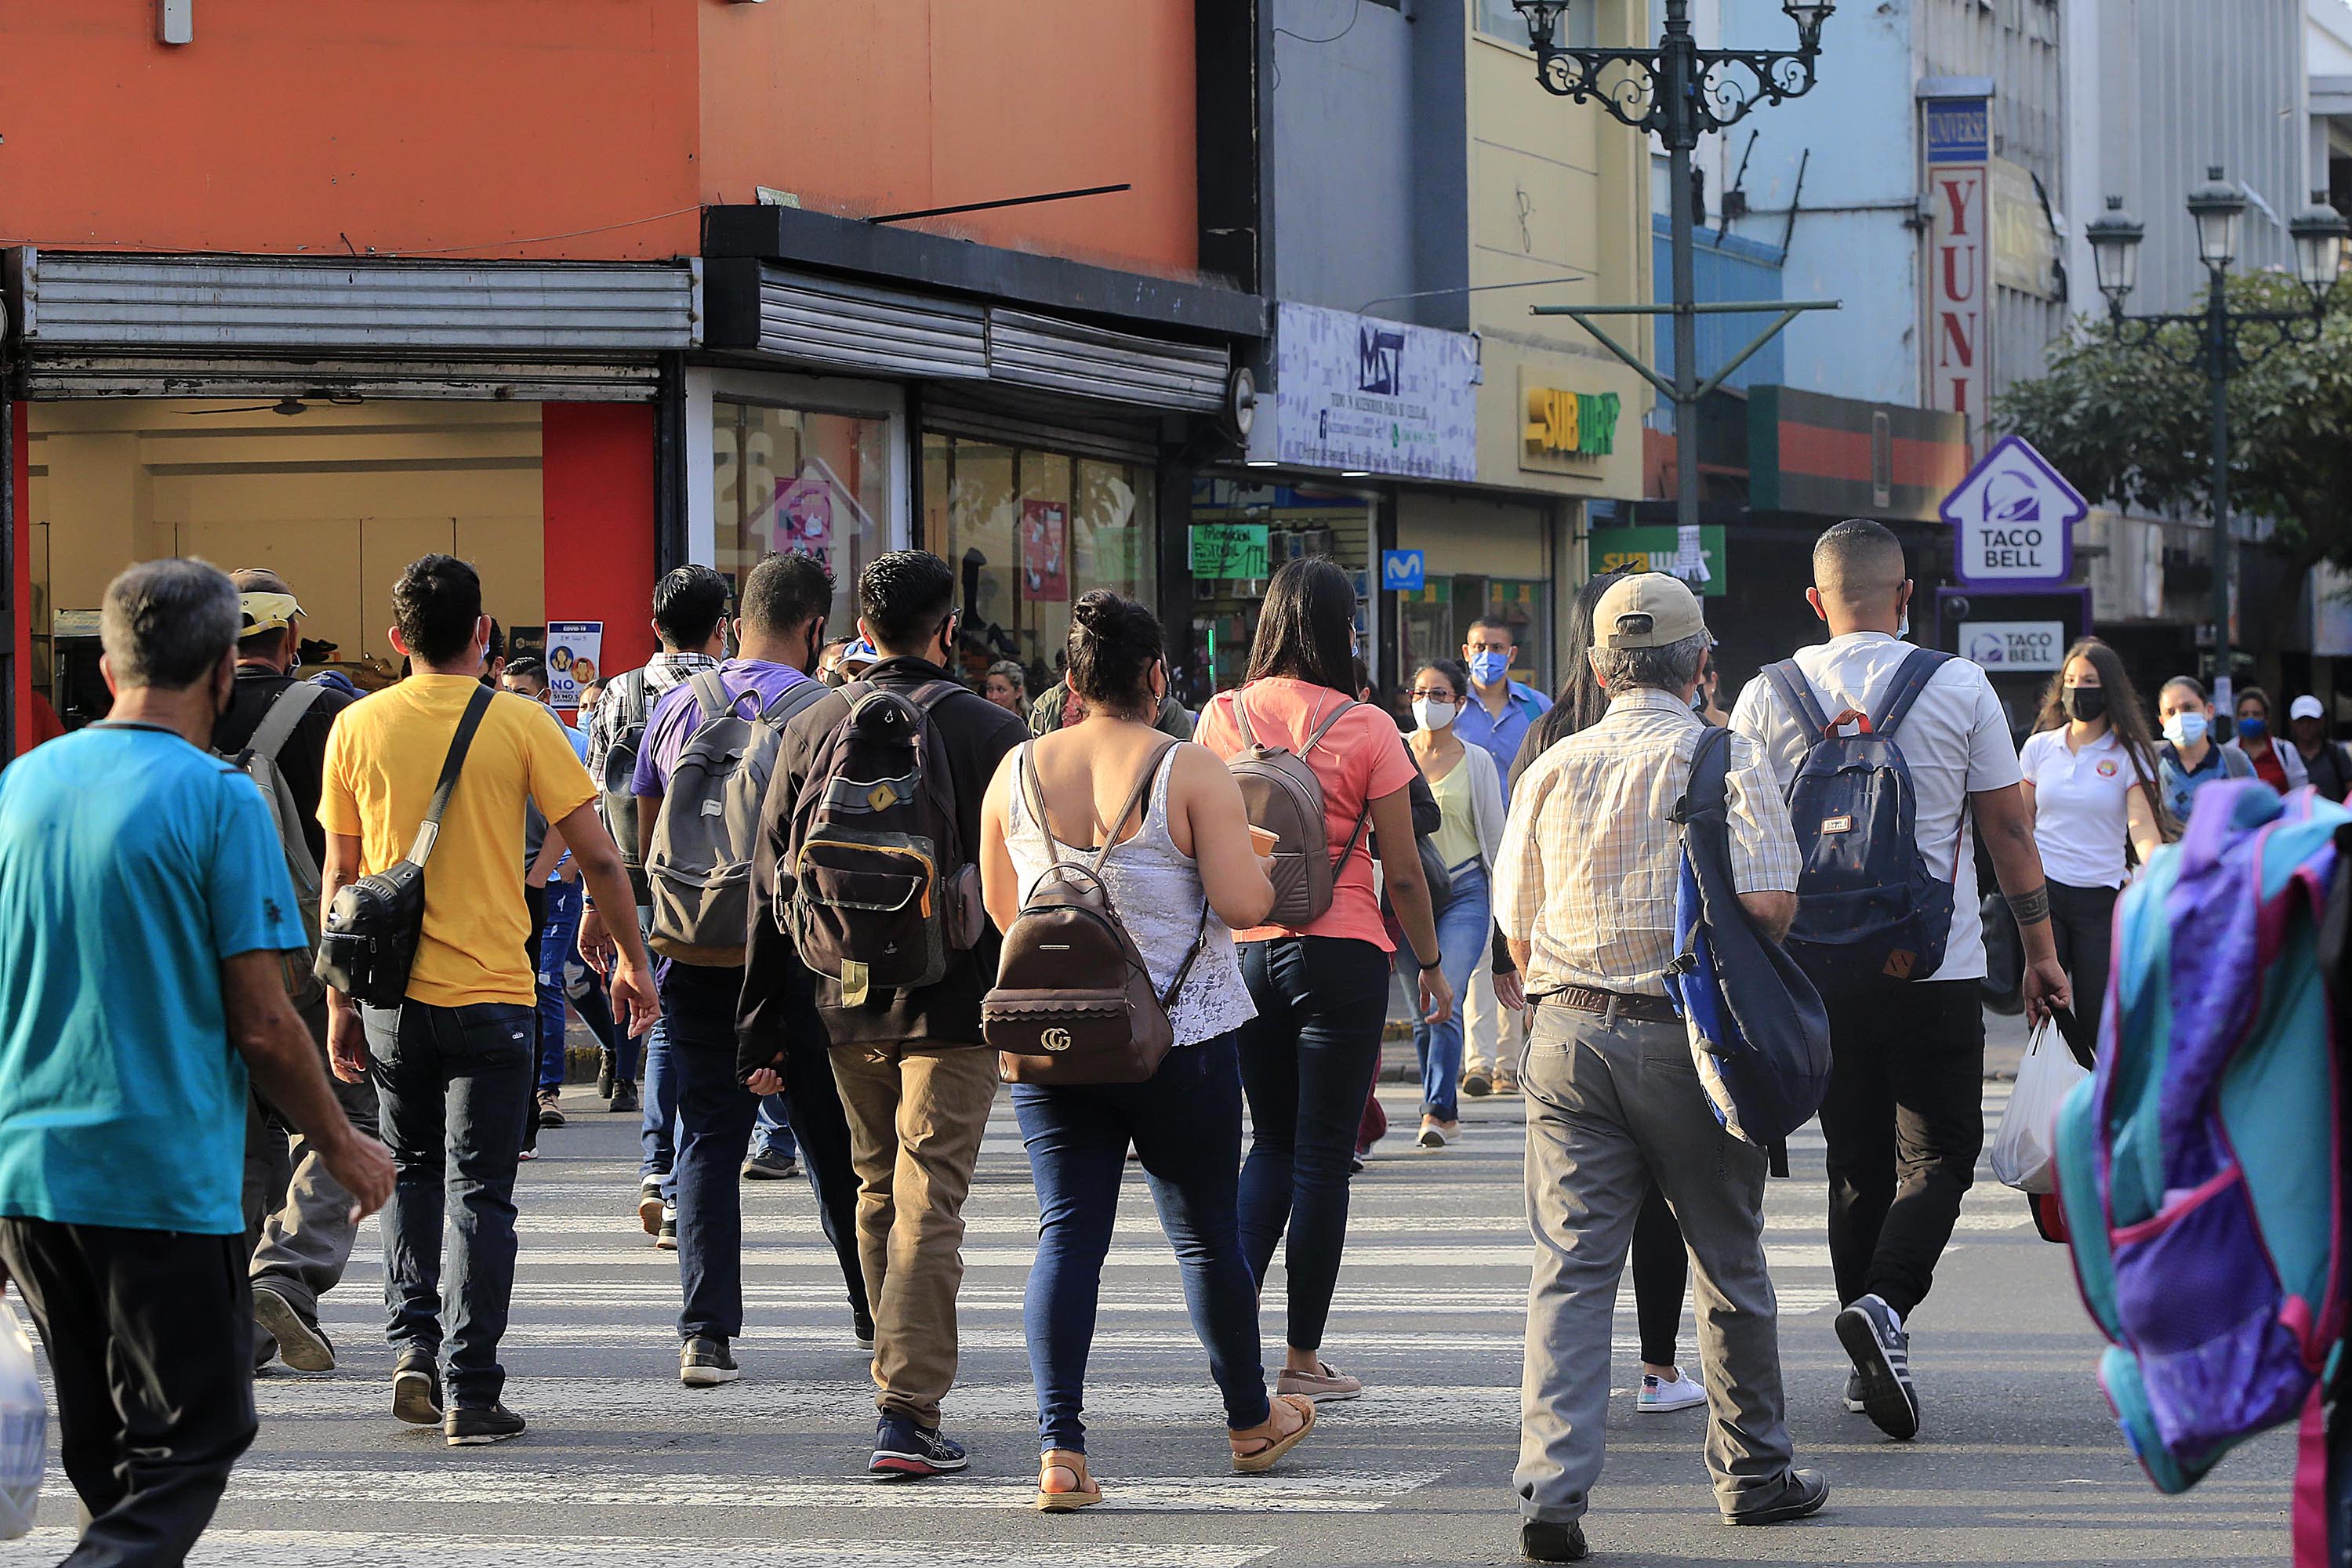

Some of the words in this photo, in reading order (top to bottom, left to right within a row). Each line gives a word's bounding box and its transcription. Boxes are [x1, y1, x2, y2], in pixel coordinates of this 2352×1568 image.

[1358, 327, 1405, 396] MST
[1980, 529, 2042, 547] TACO
[1984, 550, 2042, 568] BELL
[2005, 633, 2053, 646] TACO
[2008, 649, 2052, 663] BELL
[551, 679, 574, 690] NO
